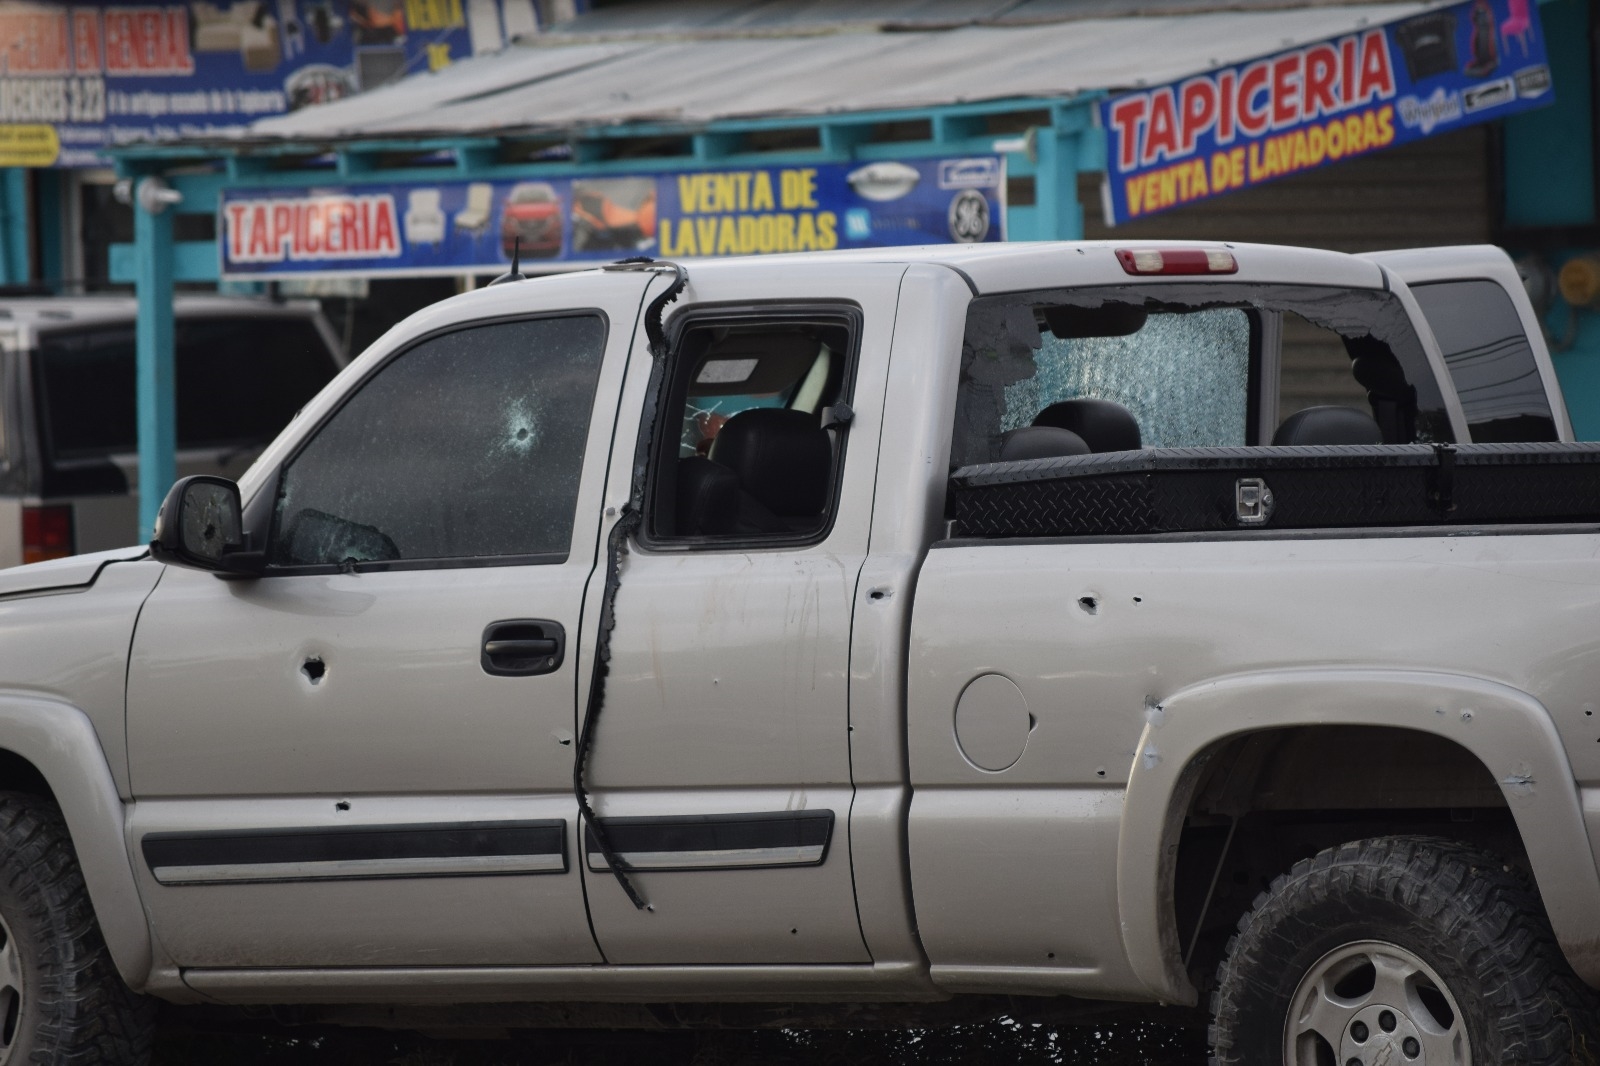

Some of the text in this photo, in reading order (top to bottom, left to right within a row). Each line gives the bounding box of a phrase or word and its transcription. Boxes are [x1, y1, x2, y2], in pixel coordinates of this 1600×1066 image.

[73, 11, 101, 71] EN
[105, 9, 193, 73] GENERAL
[1112, 29, 1395, 169] TAPICERIA
[678, 168, 819, 213] VENTA DE
[1125, 106, 1396, 217] VENTA DE LAVADORAS
[228, 197, 398, 260] TAPICERIA
[659, 211, 838, 257] LAVADORAS
